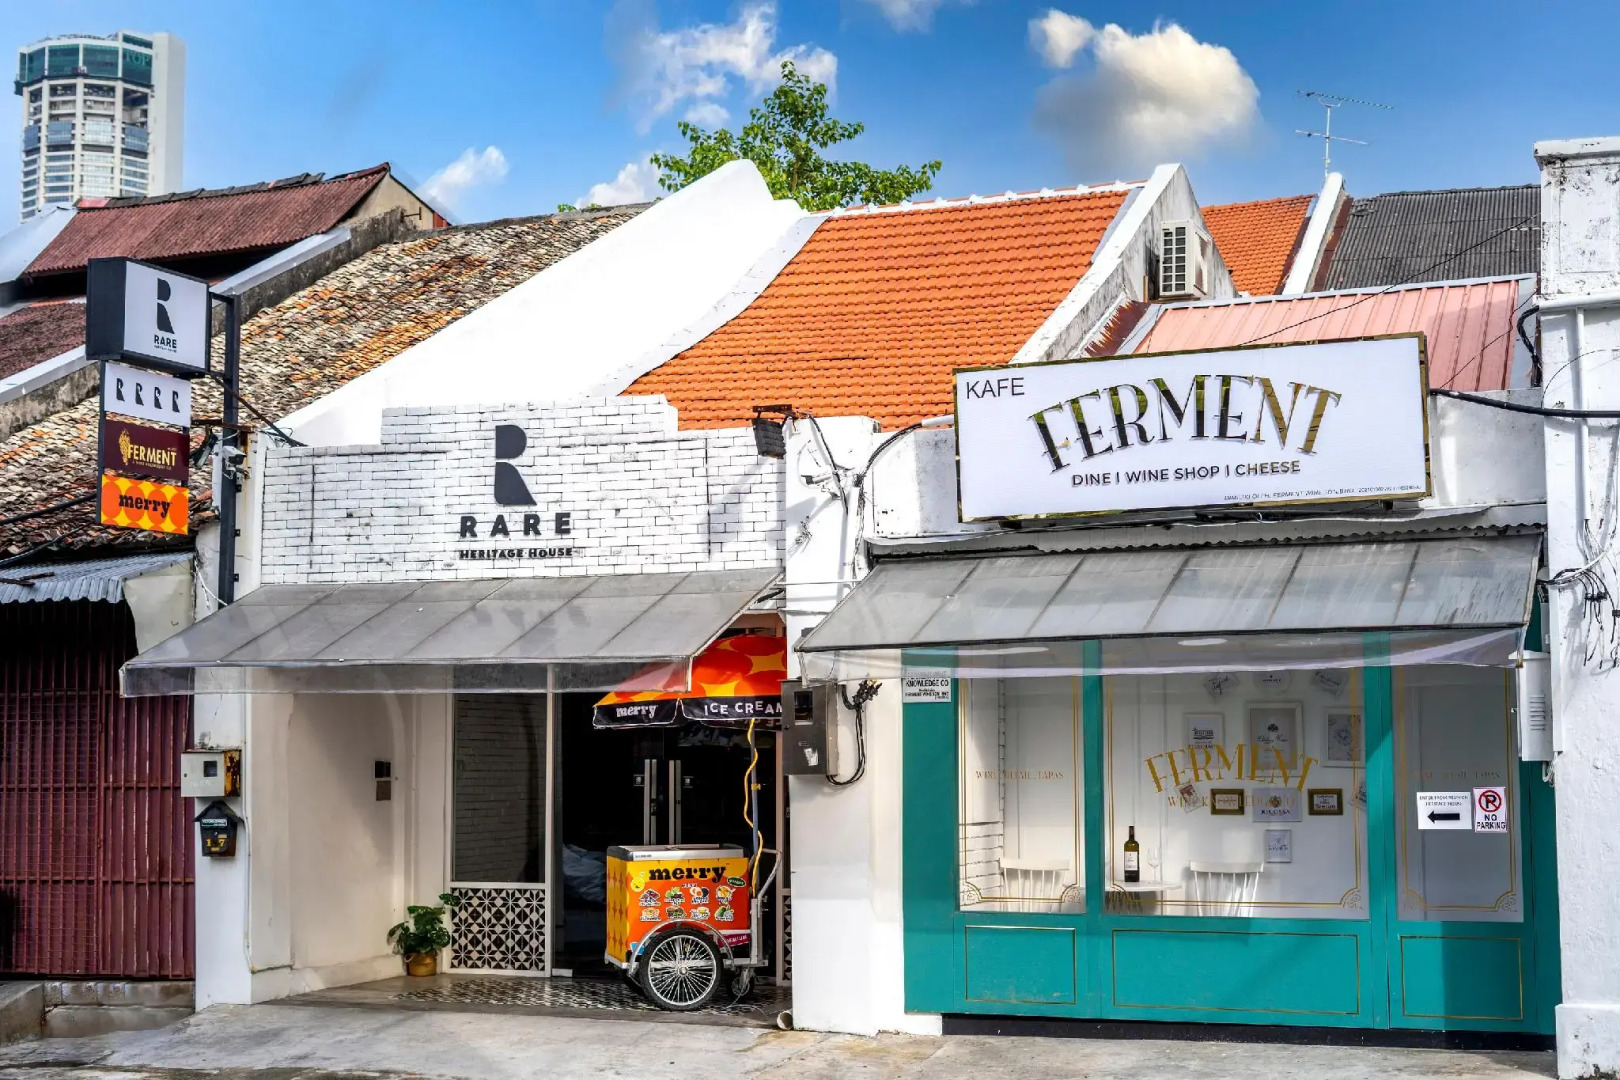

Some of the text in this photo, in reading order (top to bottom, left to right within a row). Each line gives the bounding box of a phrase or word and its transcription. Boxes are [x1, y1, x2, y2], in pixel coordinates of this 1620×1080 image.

[154, 334, 177, 349] RARE
[966, 377, 1025, 400] KAFE
[1027, 374, 1343, 475] FERMENT
[127, 444, 177, 467] FERMENT
[1072, 472, 1111, 487] DINE
[1126, 468, 1169, 484] WINE
[1174, 465, 1220, 481] SHOP
[1235, 460, 1301, 477] CHEESE
[119, 494, 171, 518] merry
[460, 512, 571, 538] RARE
[460, 547, 573, 559] HERITAGE HOUSE
[906, 679, 949, 687] KNOWLEDGE CO
[616, 704, 657, 719] merry
[704, 702, 729, 715] ICE
[1145, 743, 1320, 793] FERMENT
[1476, 821, 1506, 830] PARKING
[1484, 813, 1497, 821] NO
[649, 866, 726, 884] merry
